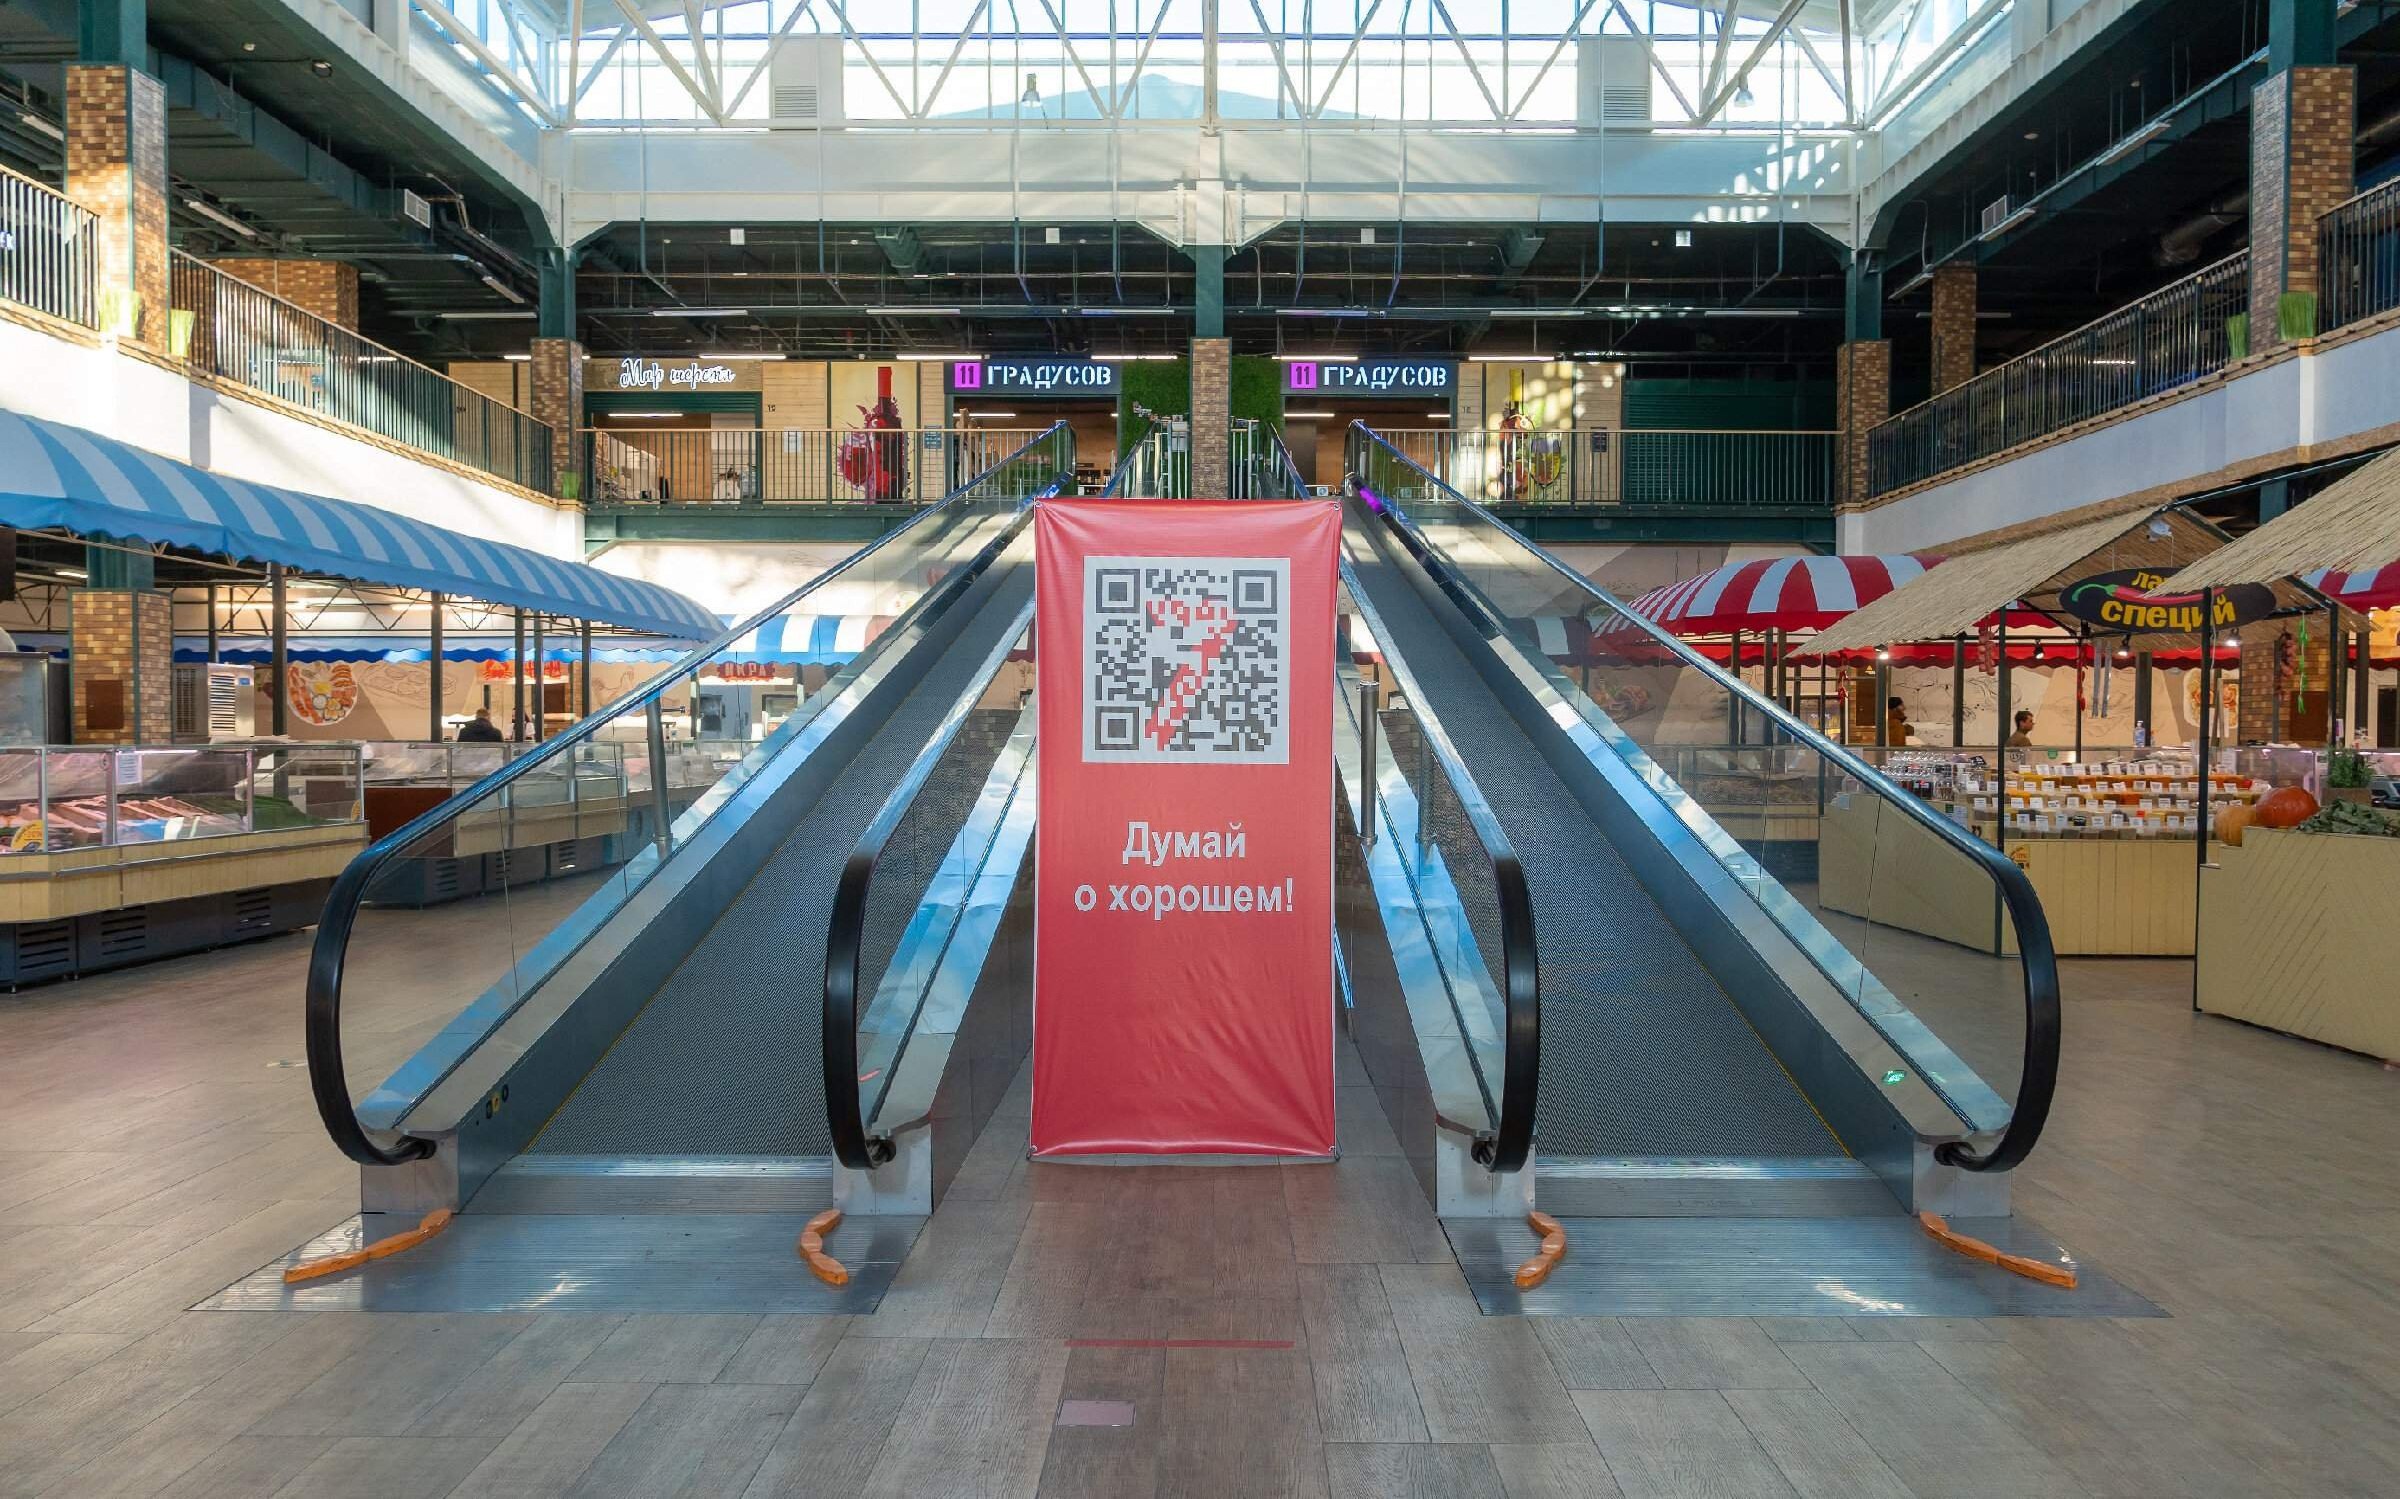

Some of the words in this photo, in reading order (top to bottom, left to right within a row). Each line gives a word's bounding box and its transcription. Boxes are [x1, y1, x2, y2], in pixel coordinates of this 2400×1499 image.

[620, 357, 664, 390] Мир
[670, 362, 736, 390] шерсти
[959, 365, 975, 385] 11
[987, 364, 1112, 390] ГРАДУСОВ
[1294, 365, 1310, 386] 11
[1323, 365, 1447, 390] ГРАДУСОВ
[724, 661, 767, 677] ИКРА
[1122, 821, 1247, 867] Думай
[1074, 883, 1097, 913] о
[1108, 878, 1295, 922] хорошем!
